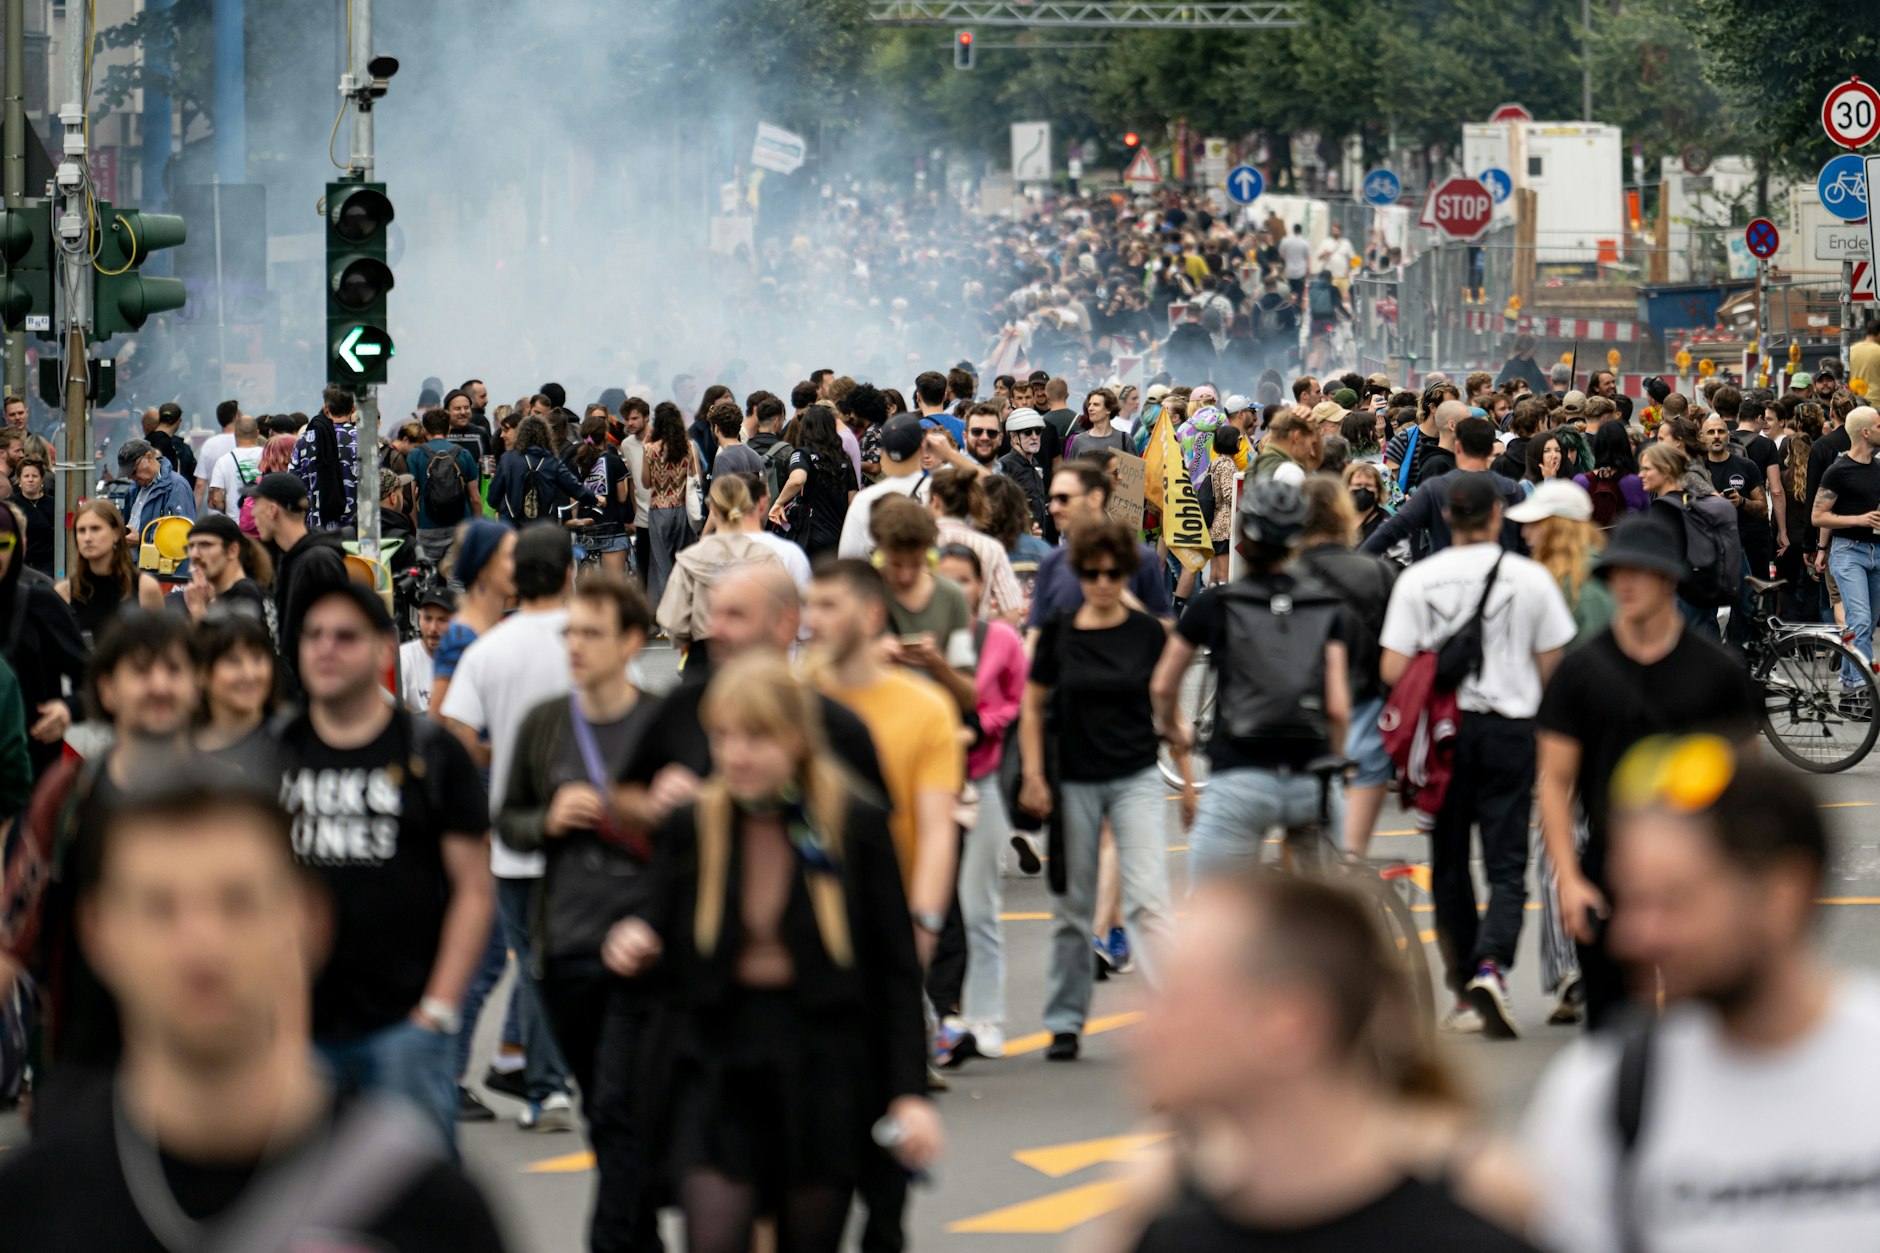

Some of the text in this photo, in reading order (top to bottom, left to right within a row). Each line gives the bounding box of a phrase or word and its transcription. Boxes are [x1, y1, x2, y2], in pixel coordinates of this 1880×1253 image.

[1836, 100, 1871, 129] 30
[1438, 195, 1489, 220] STOP
[1829, 234, 1869, 249] Ende
[1112, 494, 1143, 517] rrsinn
[290, 815, 400, 860] ONES
